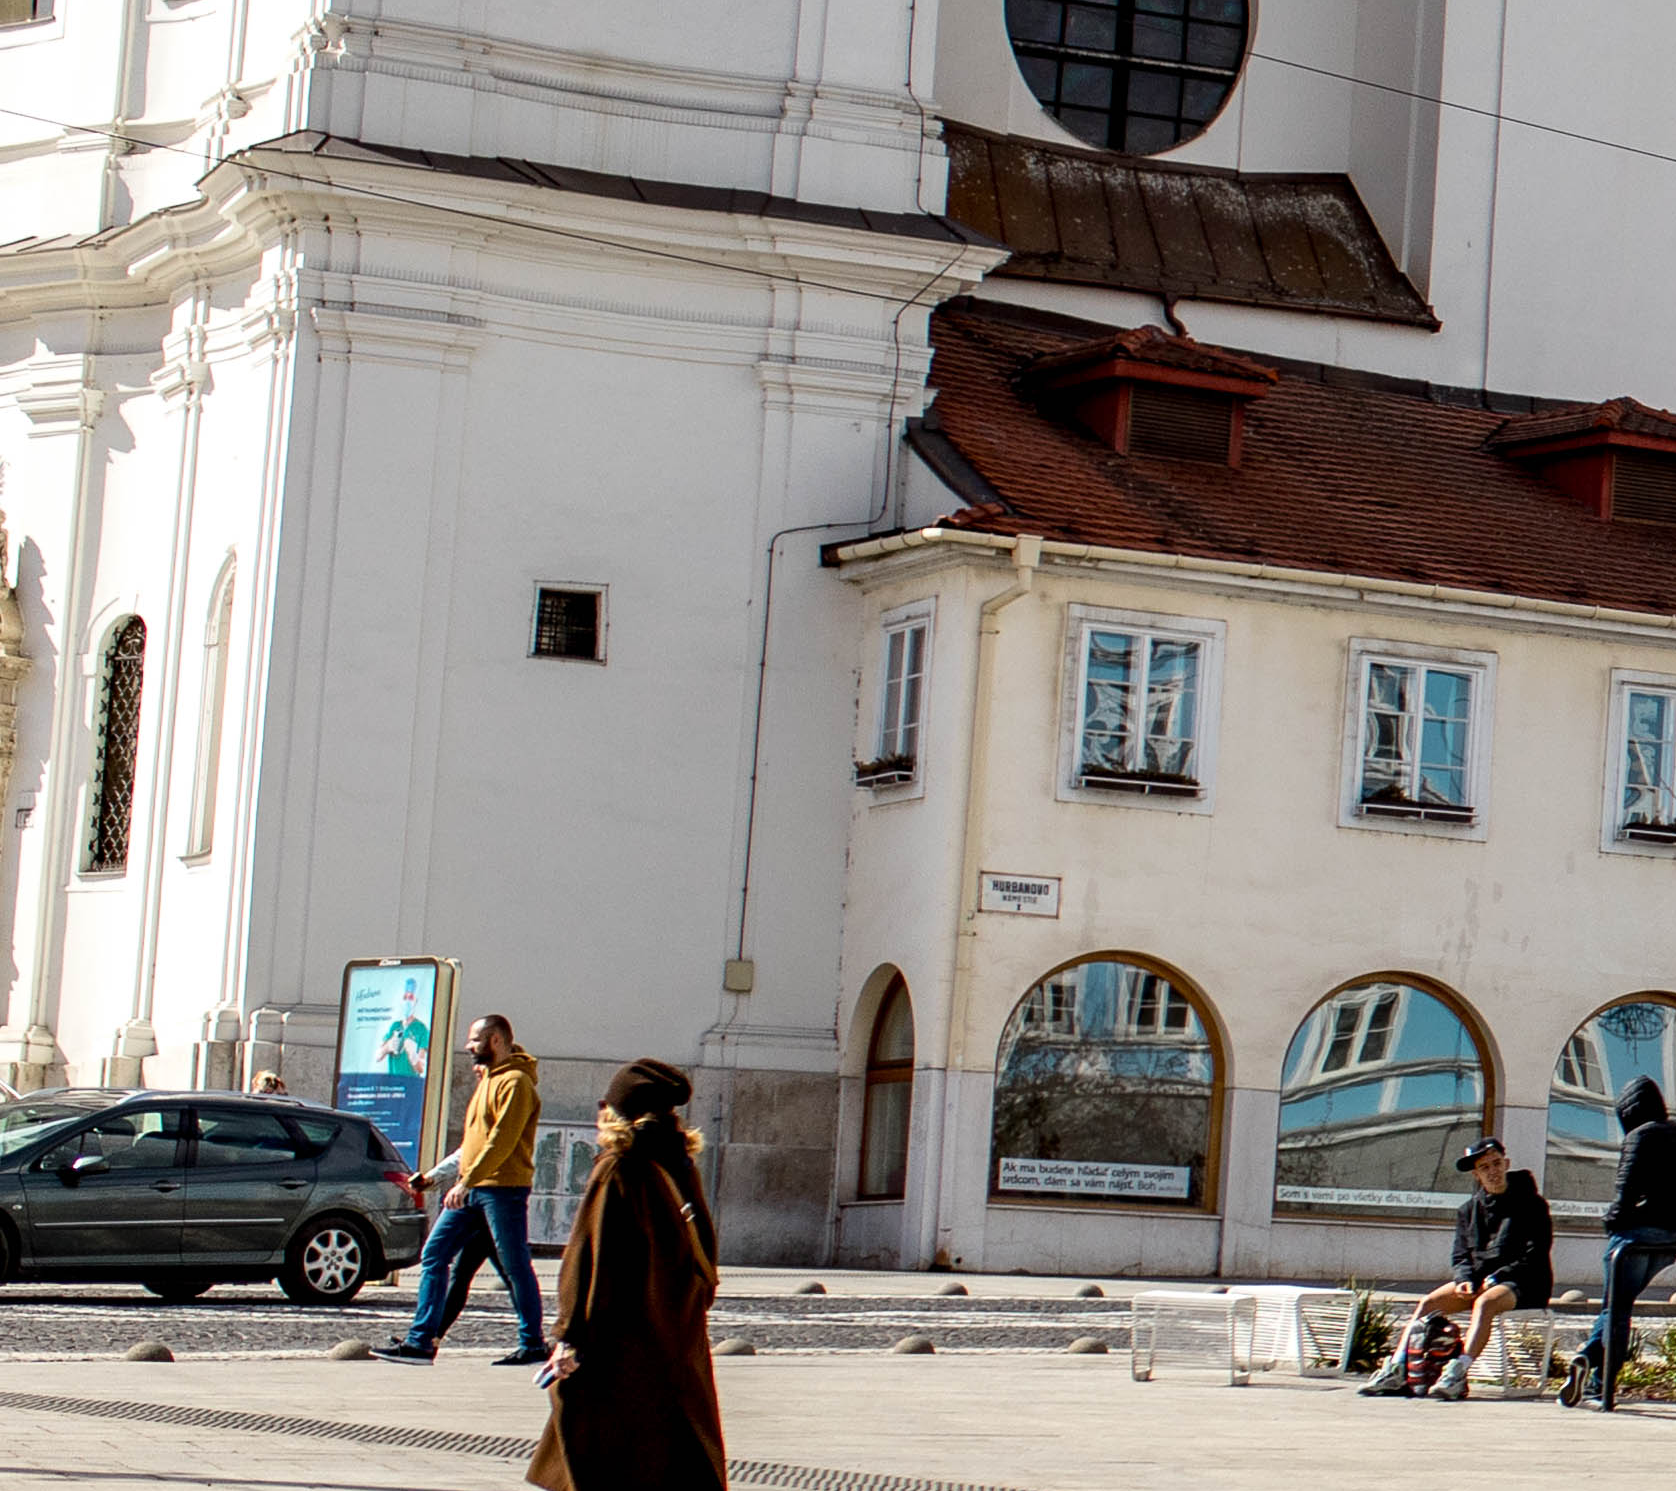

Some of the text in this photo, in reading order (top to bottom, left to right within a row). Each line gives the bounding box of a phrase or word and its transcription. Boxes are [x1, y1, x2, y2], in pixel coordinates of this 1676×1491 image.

[992, 880, 1050, 896] HURBANOVO
[1003, 1162, 1016, 1172] Ak
[1020, 1165, 1036, 1173] ma
